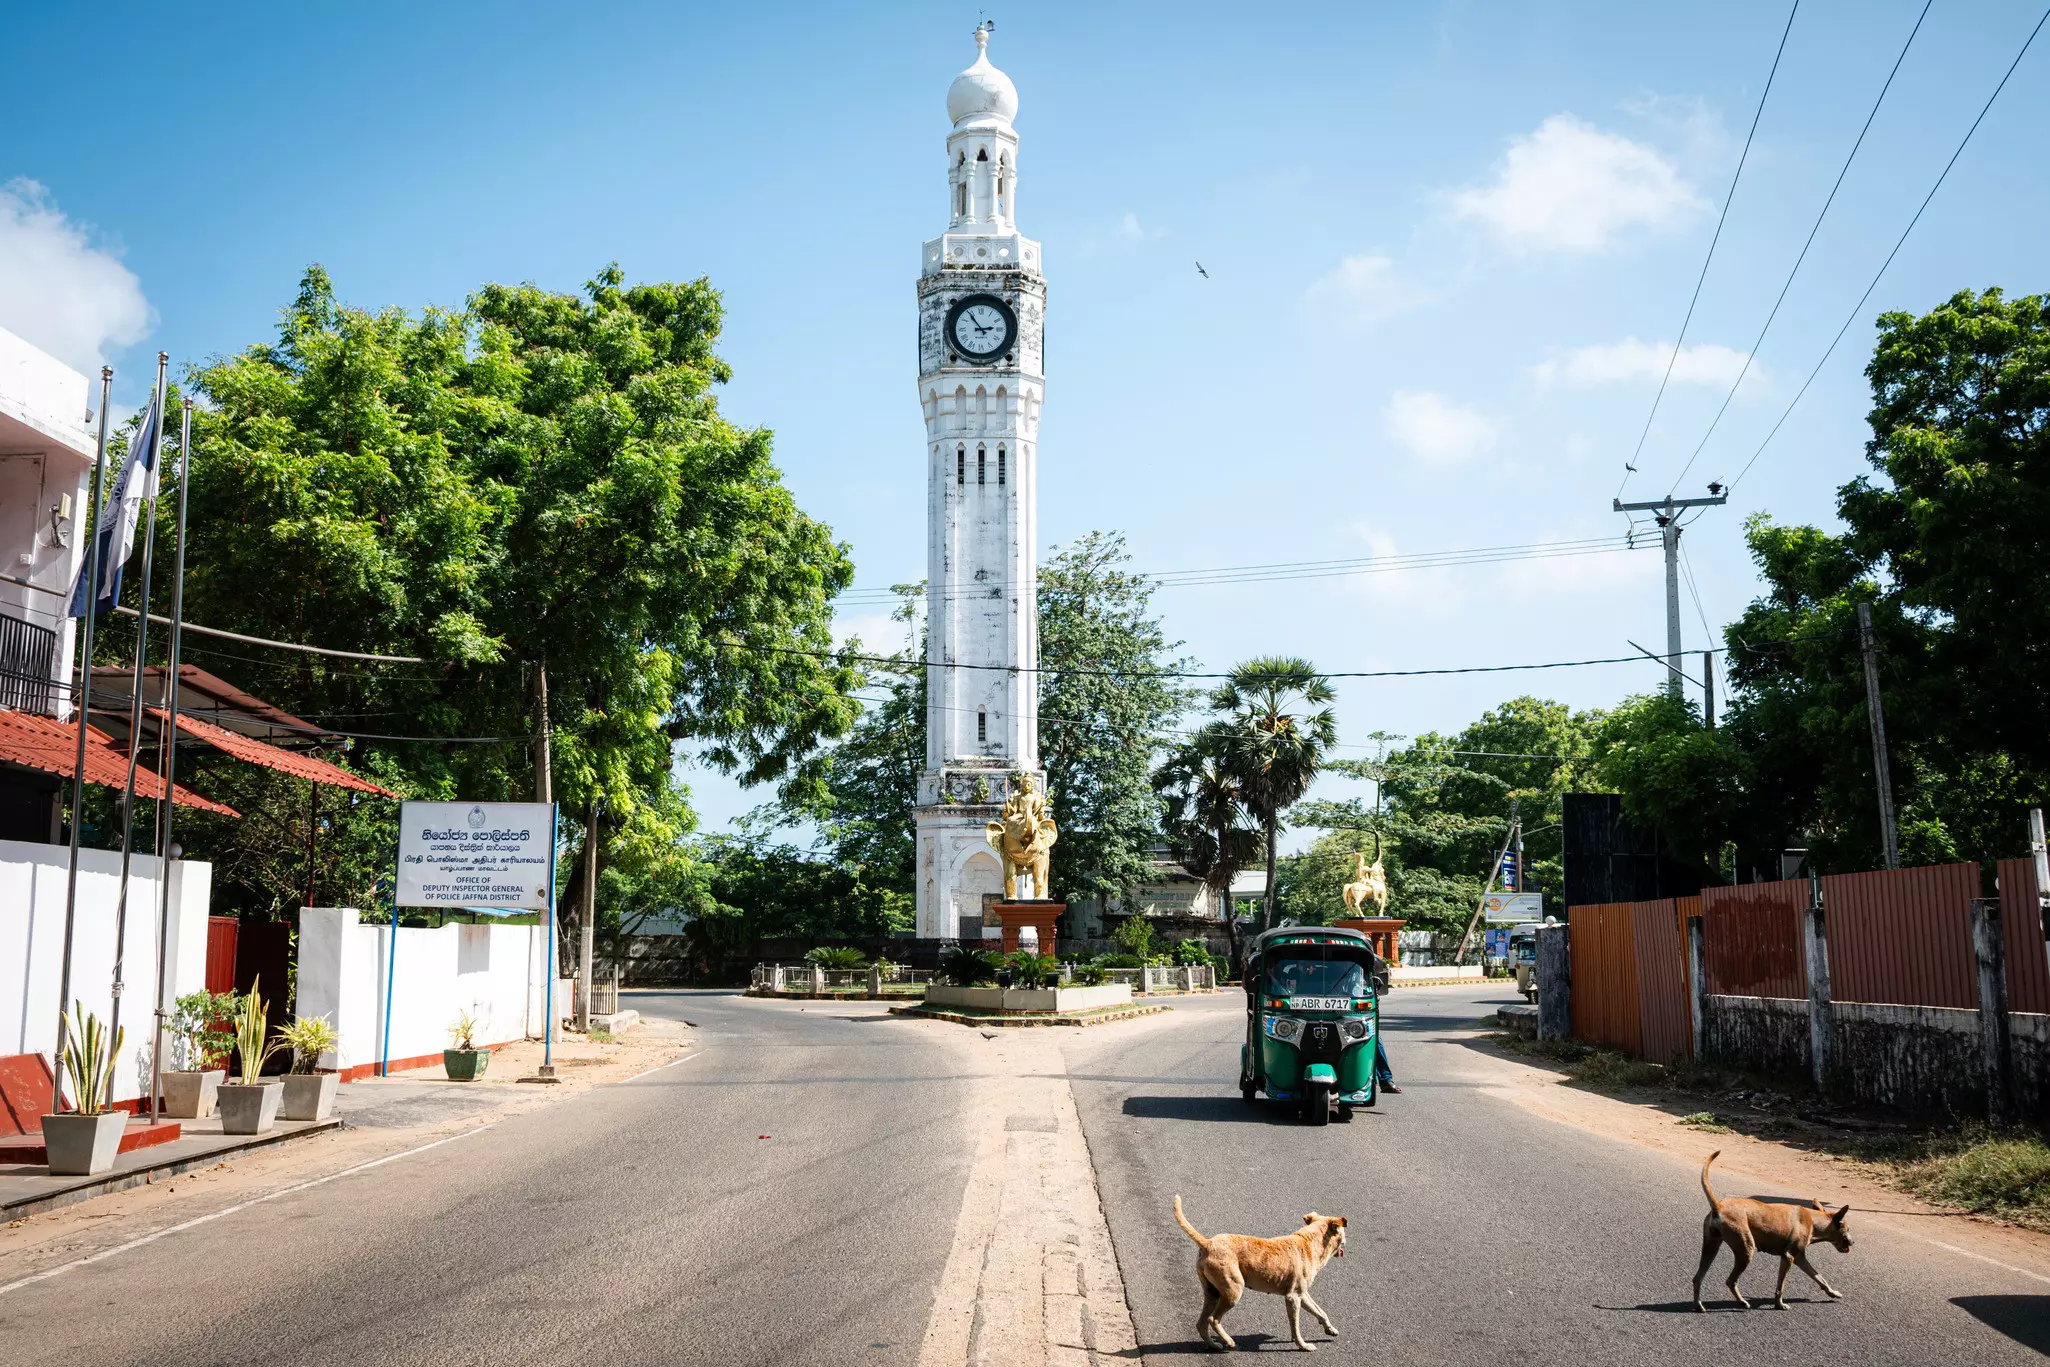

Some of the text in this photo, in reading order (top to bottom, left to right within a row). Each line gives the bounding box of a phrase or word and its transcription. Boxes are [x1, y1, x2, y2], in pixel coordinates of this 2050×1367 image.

[472, 829, 530, 842] පොලිස්පති
[404, 855, 546, 865] பிரதி பொலிஸ்மா அதிபர் காரியாலயம்
[491, 885, 524, 893] GENERAL
[1301, 999, 1320, 1009] ABR
[1324, 999, 1349, 1009] 6717
